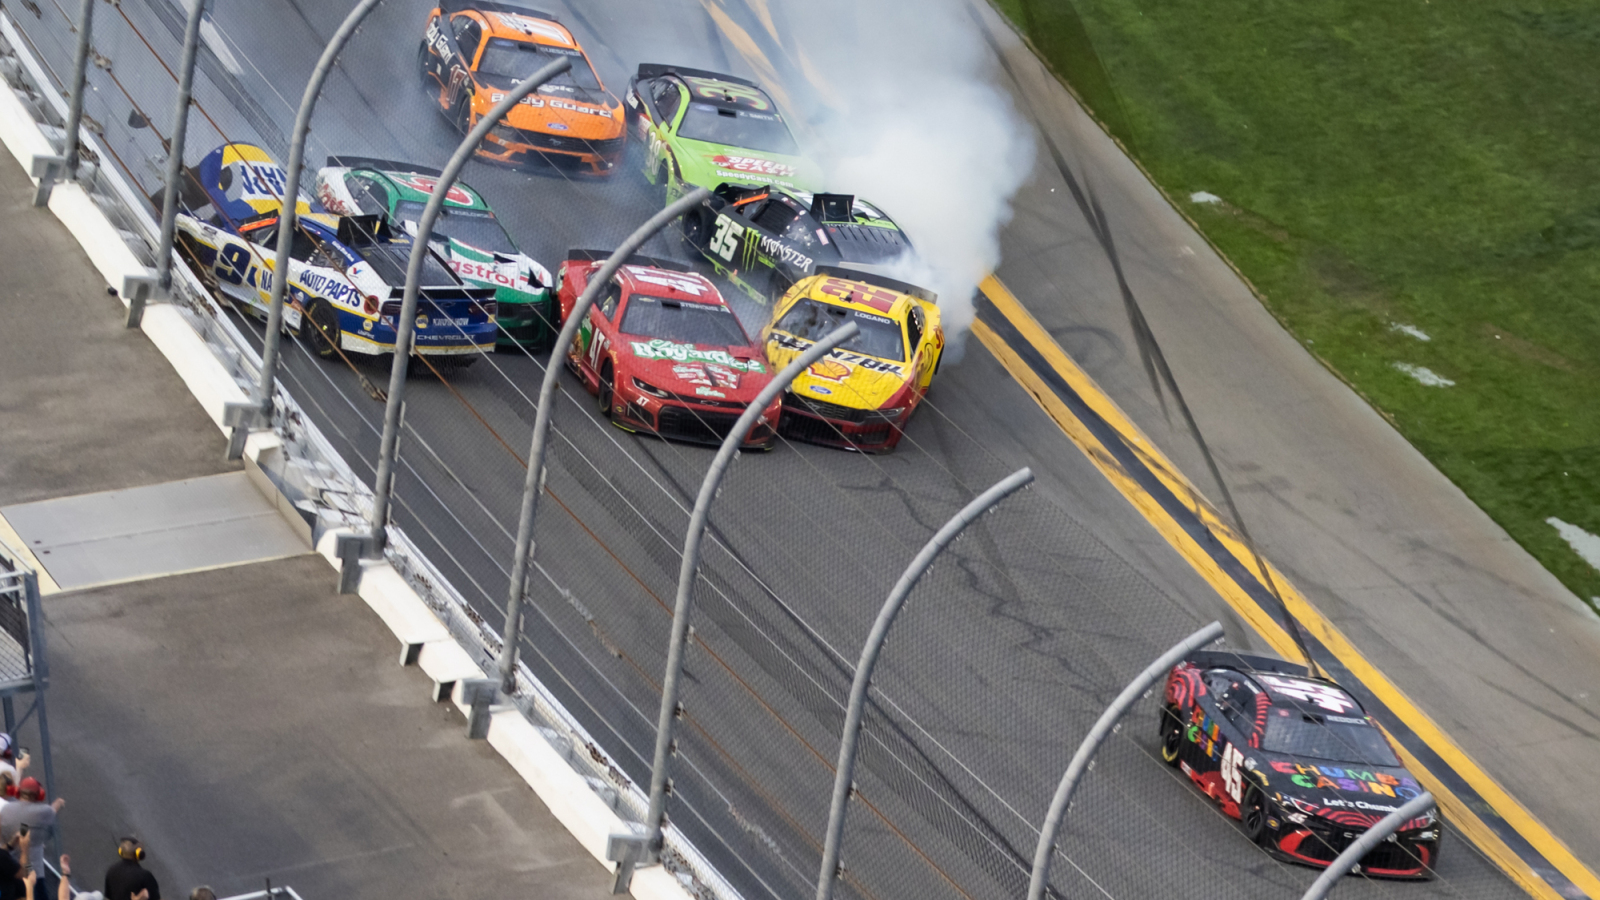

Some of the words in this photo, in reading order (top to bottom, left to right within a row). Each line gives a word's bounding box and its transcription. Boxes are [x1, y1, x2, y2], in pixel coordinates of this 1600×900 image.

[491, 92, 545, 108] Bdy
[550, 99, 612, 118] Guard
[716, 169, 794, 188] SpeedyCash.com
[728, 156, 796, 172] SPEEDY
[709, 213, 745, 263] 35
[215, 242, 252, 286] 9
[446, 259, 516, 288] astrol
[300, 269, 327, 293] AUTO
[322, 279, 361, 308] PARTS
[854, 311, 891, 325] LOGANO
[630, 342, 766, 374] Boyardee
[1220, 741, 1245, 804] 45
[1269, 760, 1421, 794] CHUMBA
[1291, 773, 1419, 801] CASINO
[1323, 797, 1355, 809] Let's
[1355, 800, 1401, 814] Chumb
